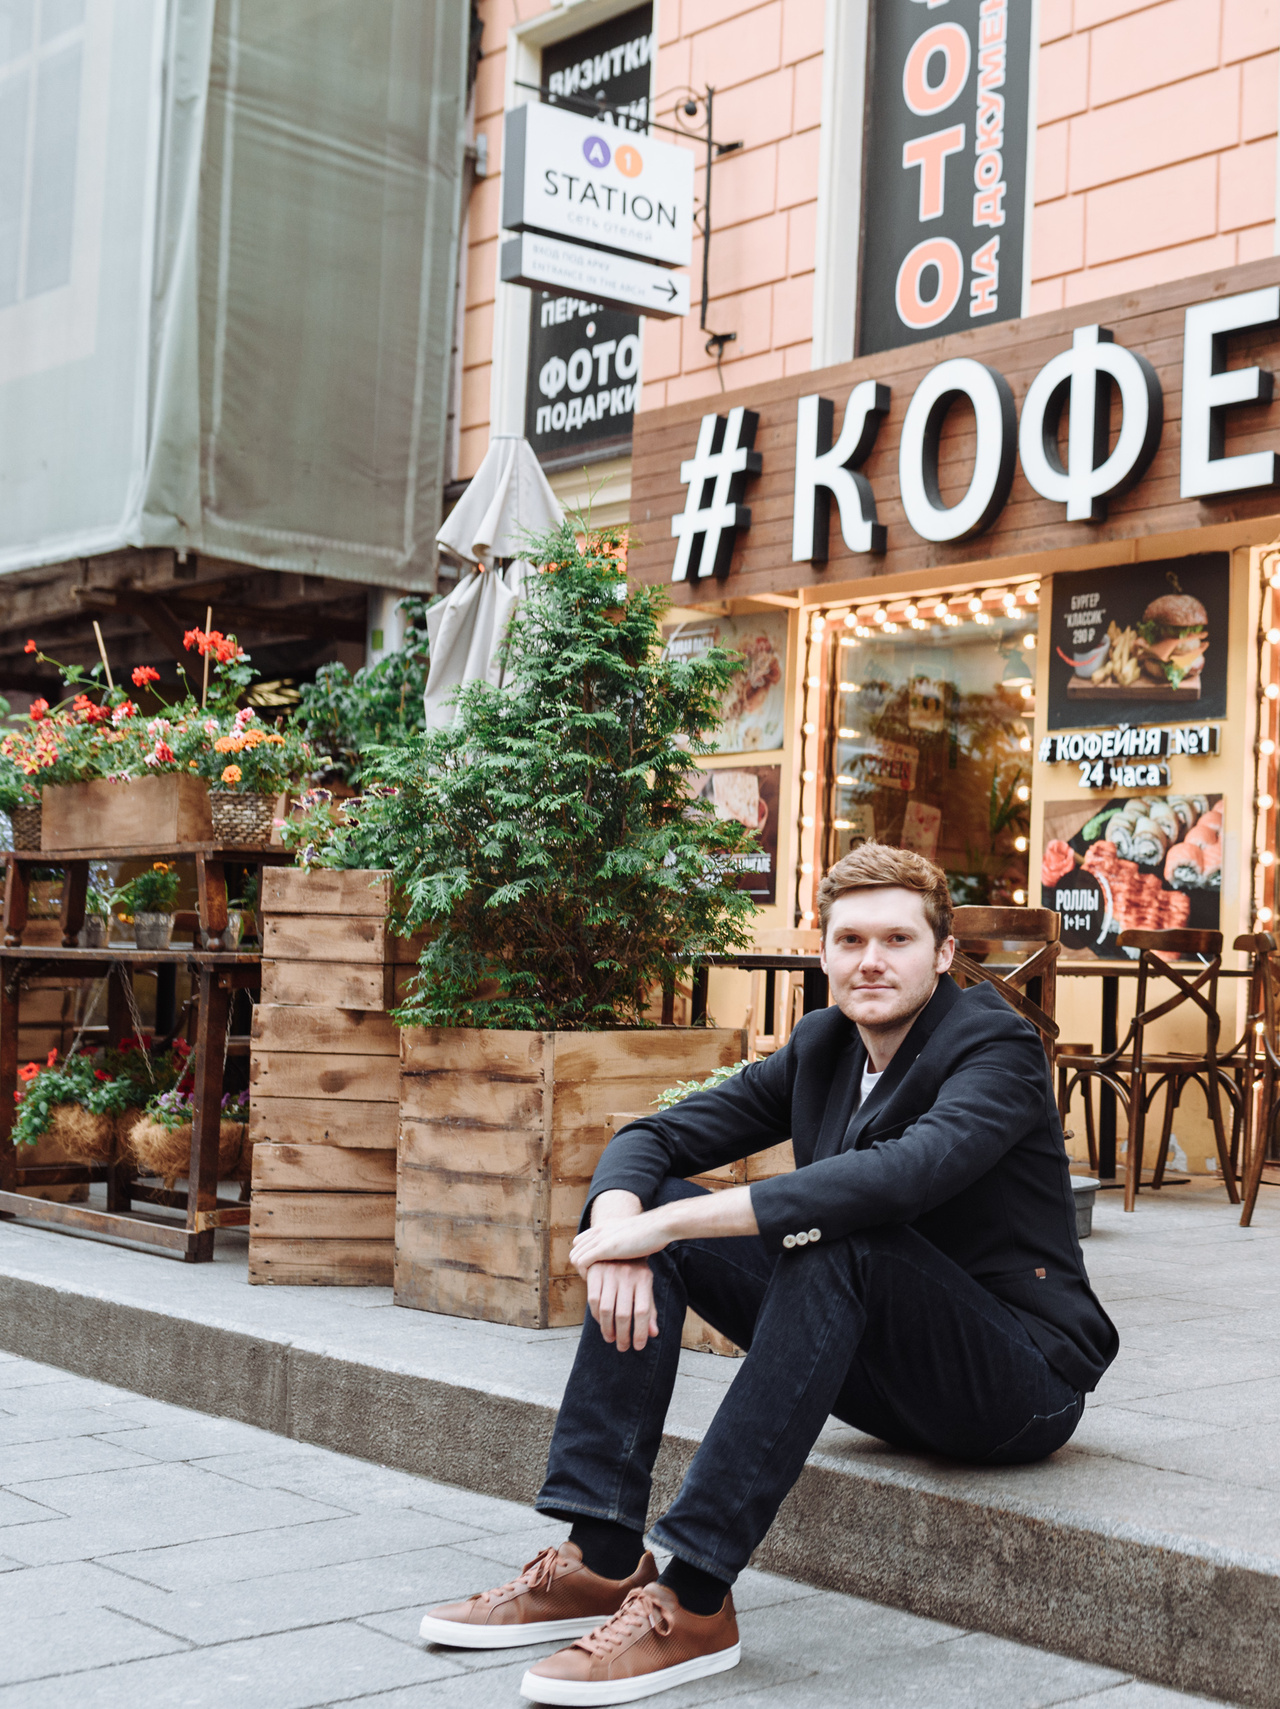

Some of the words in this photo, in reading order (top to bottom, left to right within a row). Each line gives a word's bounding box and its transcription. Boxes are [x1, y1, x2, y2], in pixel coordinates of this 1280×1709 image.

[895, 0, 972, 330] ОТО
[544, 169, 677, 230] STATION
[567, 211, 599, 231] сеть
[603, 219, 653, 243] отелей
[561, 251, 585, 268] ПОД
[532, 261, 584, 283] ENTRANCE
[586, 273, 598, 285] IN
[600, 277, 618, 290] THE
[619, 282, 647, 298] ARCH
[969, 234, 1000, 318] НА
[539, 334, 639, 399] ФОТО
[536, 384, 639, 435] ПОДАРКИ
[1071, 592, 1100, 611] БУРГЕР
[1064, 608, 1107, 628] "КЛАССИК"
[1175, 725, 1211, 755] №1
[1078, 760, 1105, 788] 24
[1109, 763, 1161, 788] часа
[1055, 889, 1099, 912] РОЛЛЫ
[1063, 913, 1091, 931] 1+1=1
